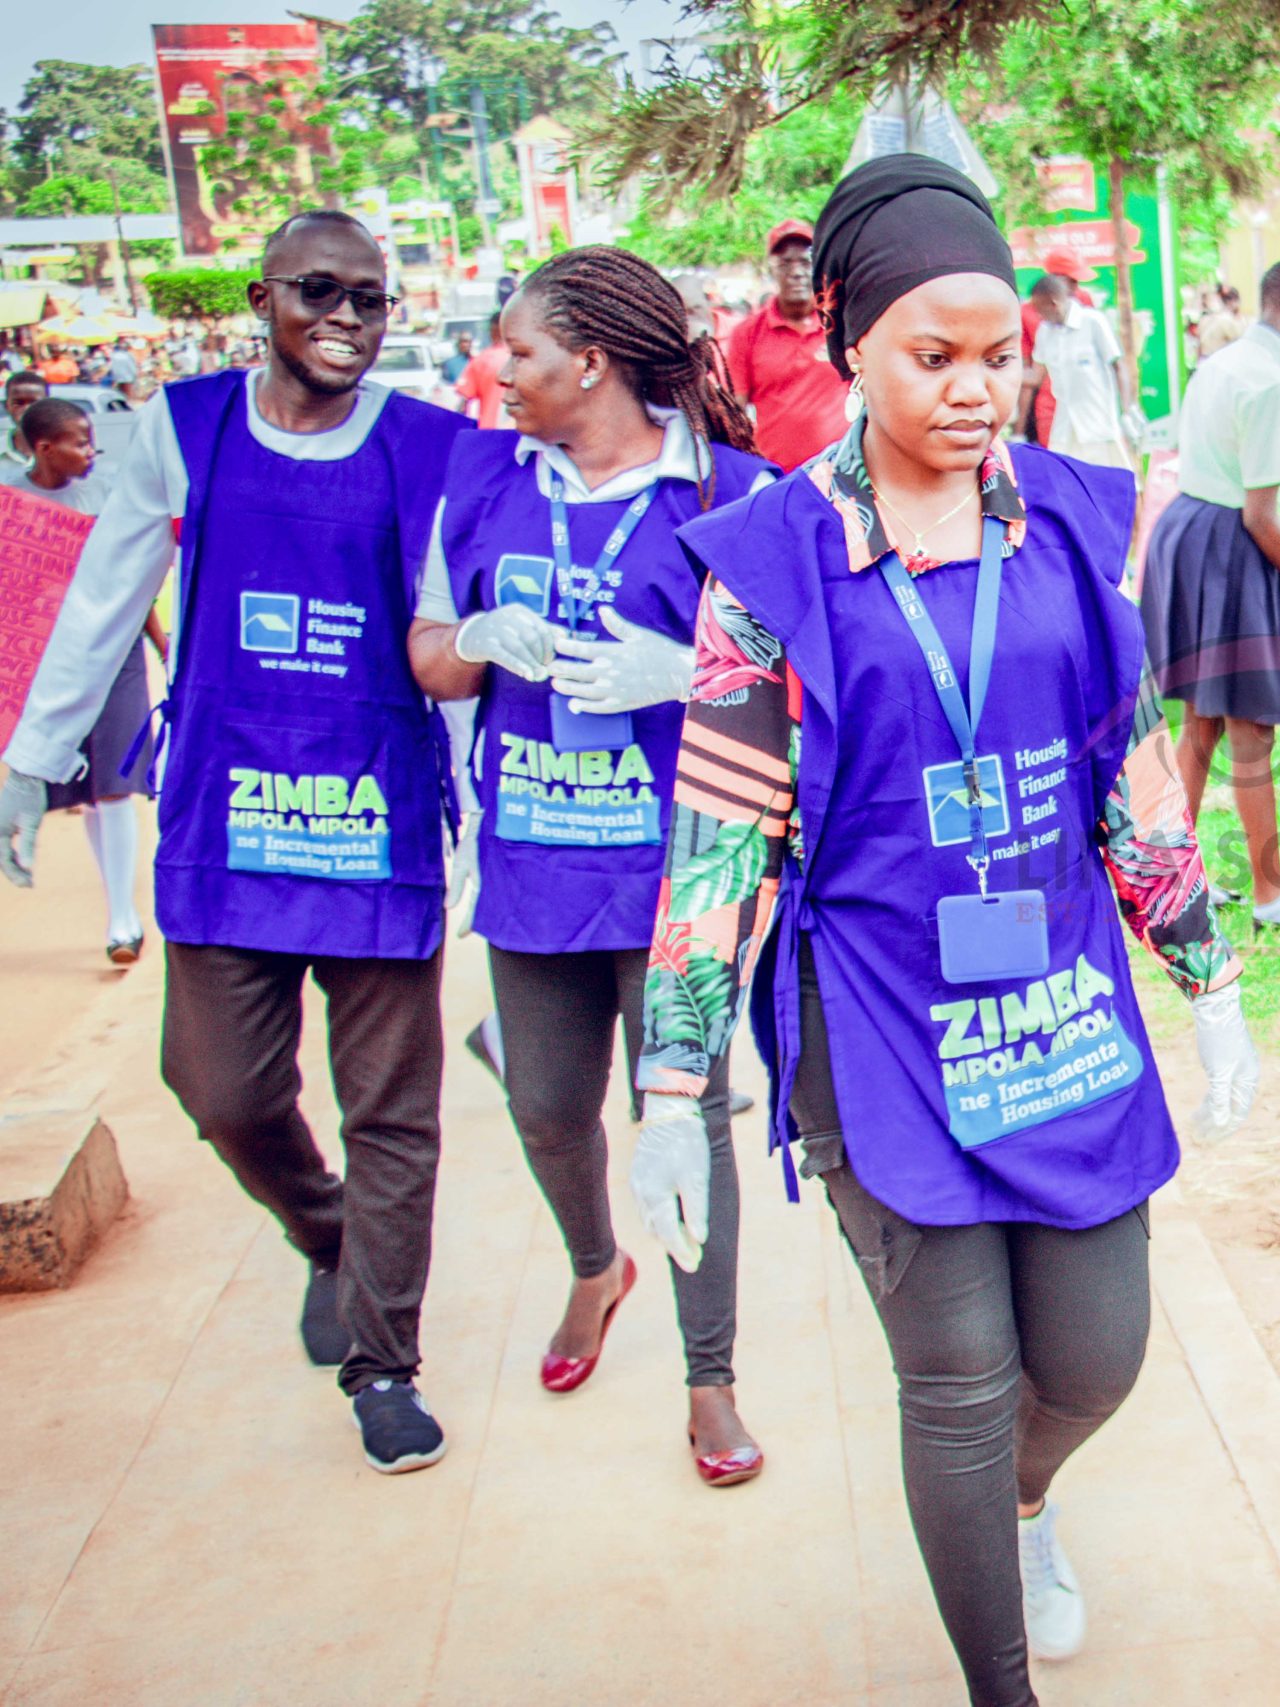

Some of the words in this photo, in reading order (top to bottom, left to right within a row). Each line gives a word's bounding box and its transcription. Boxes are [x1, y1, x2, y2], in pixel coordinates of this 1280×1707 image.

[307, 598, 367, 623] Housing
[306, 618, 363, 638] Finance
[305, 637, 346, 656] Bank
[258, 658, 280, 670] we
[279, 659, 311, 673] make
[311, 660, 321, 673] it
[321, 664, 349, 679] easy
[500, 731, 655, 787] ZIMBA
[1014, 738, 1068, 771] Housing
[228, 766, 390, 816] ZIMBA
[499, 774, 568, 804] MPOLA
[573, 784, 654, 807] MPOLA
[1018, 767, 1067, 798] Finance
[228, 808, 305, 833] MPOLA
[307, 815, 389, 836] MPOLA
[504, 801, 528, 817] ne
[530, 802, 645, 827] Incremental
[1021, 794, 1058, 825] Bank
[234, 835, 260, 849] ne
[263, 834, 379, 856] Incremental
[529, 819, 599, 845] Housing
[600, 828, 646, 843] Loan
[992, 840, 1031, 861] make
[1030, 835, 1040, 850] it
[1039, 827, 1062, 846] easy
[263, 850, 334, 874] Housing
[333, 857, 380, 872] Loan
[929, 953, 1115, 1060] ZIMBA
[940, 1041, 1045, 1088] MPOLA
[1050, 1004, 1114, 1058] MPOL
[958, 1091, 991, 1113] ne
[1000, 1080, 1085, 1126] Housing
